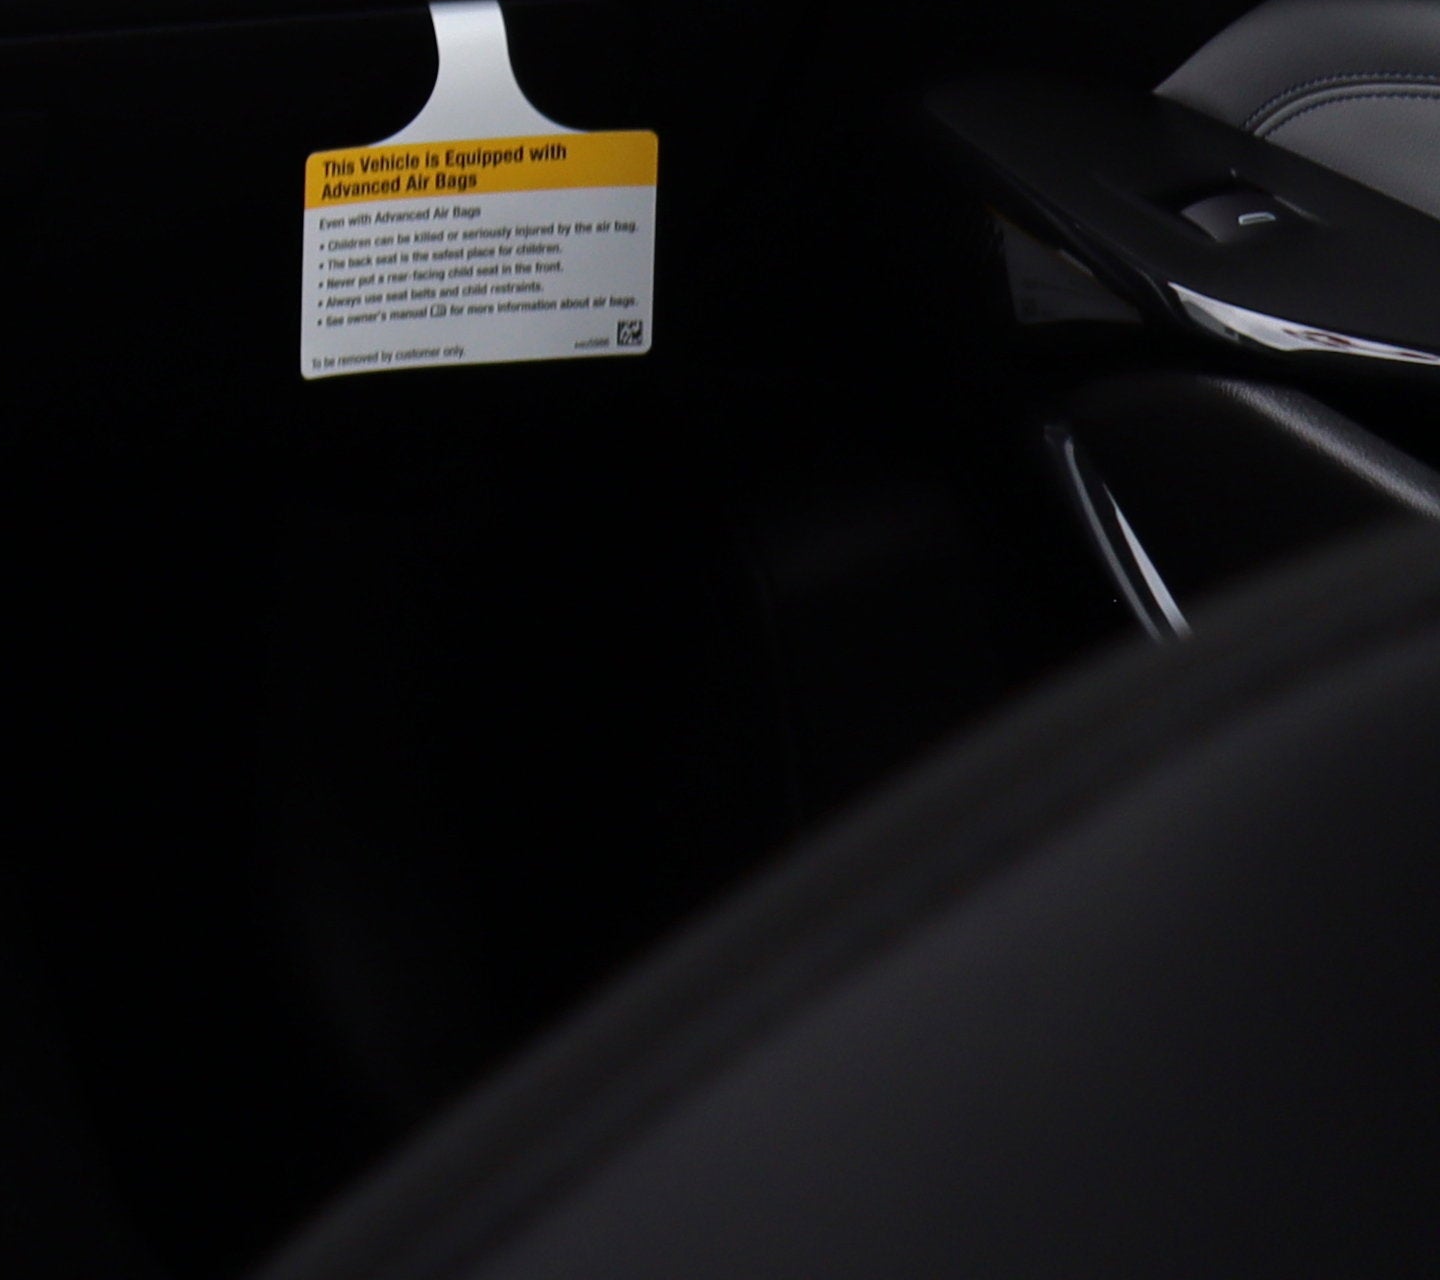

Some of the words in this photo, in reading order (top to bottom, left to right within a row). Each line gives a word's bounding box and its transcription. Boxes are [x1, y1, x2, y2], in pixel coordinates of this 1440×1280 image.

[323, 159, 354, 177] This
[360, 154, 419, 173] Vehicle
[425, 151, 439, 168] is
[445, 145, 524, 170] Equipped
[529, 143, 567, 161] with
[321, 177, 400, 199] Advanced
[406, 174, 429, 191] Air
[435, 171, 477, 193] Bags
[319, 217, 345, 230] Even
[348, 213, 372, 226] with
[374, 208, 430, 224] Advanced
[433, 207, 449, 219] Air
[453, 205, 481, 219] Bags
[328, 237, 371, 250] Children
[374, 236, 394, 246] can
[397, 233, 410, 244] be
[413, 230, 444, 243] killed
[447, 231, 458, 240] or
[462, 226, 511, 242] seriously
[515, 223, 554, 237] injured
[558, 222, 570, 236] by
[574, 221, 592, 233] the
[596, 220, 610, 232] air
[328, 258, 345, 270] The
[348, 255, 372, 267] back
[375, 253, 397, 265] seat
[400, 251, 408, 262] is
[412, 250, 428, 261] the
[432, 248, 464, 260] safest
[467, 246, 495, 261] place
[498, 245, 513, 256] for
[326, 276, 354, 289] Never
[358, 274, 375, 288] put
[448, 266, 473, 278] child
[476, 264, 498, 276] seat
[502, 263, 512, 274] in
[514, 262, 531, 273] the
[326, 295, 360, 309] Always
[364, 293, 382, 304] use
[385, 289, 407, 301] seat
[410, 287, 435, 299] belts
[439, 285, 458, 297] and
[461, 283, 487, 295] child
[326, 314, 343, 326] See
[347, 310, 386, 324] owner's
[389, 307, 427, 319] manual
[450, 304, 463, 315] for
[467, 303, 494, 313] more
[497, 298, 556, 312] information
[560, 296, 589, 308] about
[592, 296, 606, 307] air
[323, 356, 335, 366] be
[338, 352, 378, 365] removed
[381, 351, 392, 363] by
[395, 347, 440, 360] customer
